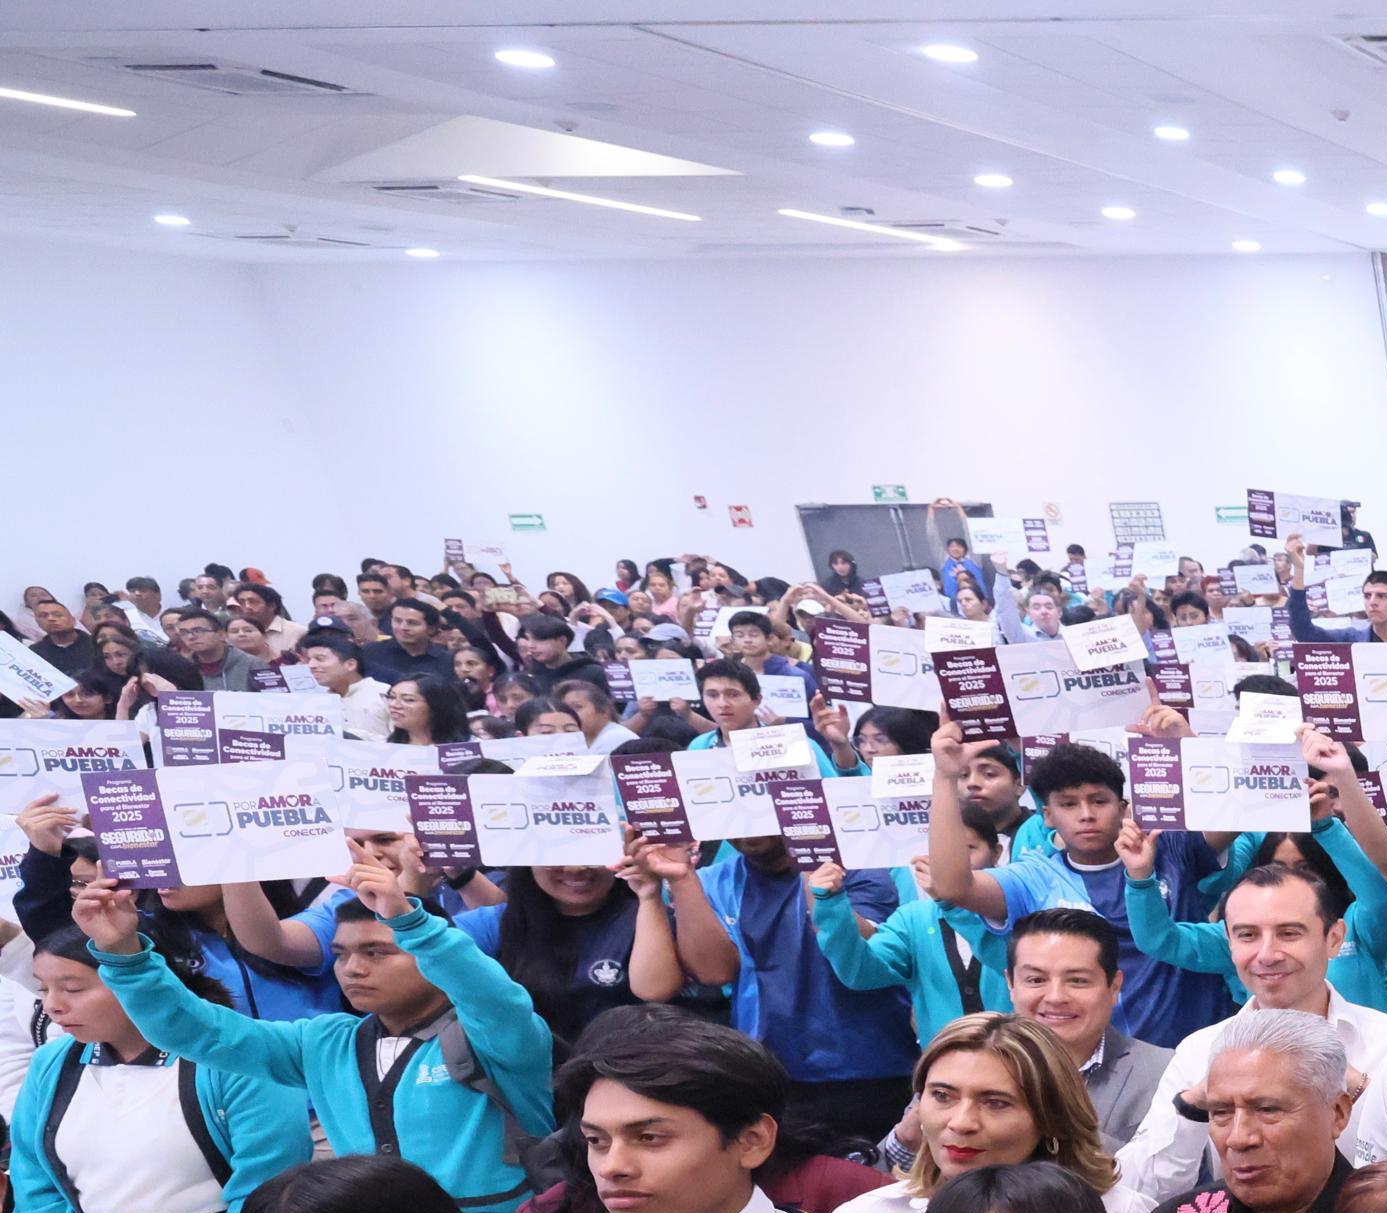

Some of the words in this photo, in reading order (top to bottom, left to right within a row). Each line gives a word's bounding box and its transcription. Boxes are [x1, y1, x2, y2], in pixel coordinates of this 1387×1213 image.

[960, 680, 985, 690] 2025
[1064, 671, 1140, 691] PUEBLA
[1314, 677, 1338, 686] 2025
[66, 747, 120, 757] AMOR
[43, 759, 136, 772] PUEBLA
[1250, 765, 1291, 776] AMOR
[1234, 777, 1302, 790] PUEBLA
[99, 786, 129, 794] Becas
[90, 792, 155, 804] Conectividad
[234, 802, 257, 810] POR
[258, 795, 312, 809] AMOR
[552, 802, 596, 812] AMOR
[112, 810, 143, 822] 2025
[237, 807, 332, 828] PUEBLA
[533, 813, 610, 825] PUEBLA
[283, 829, 328, 838] CONECTA
